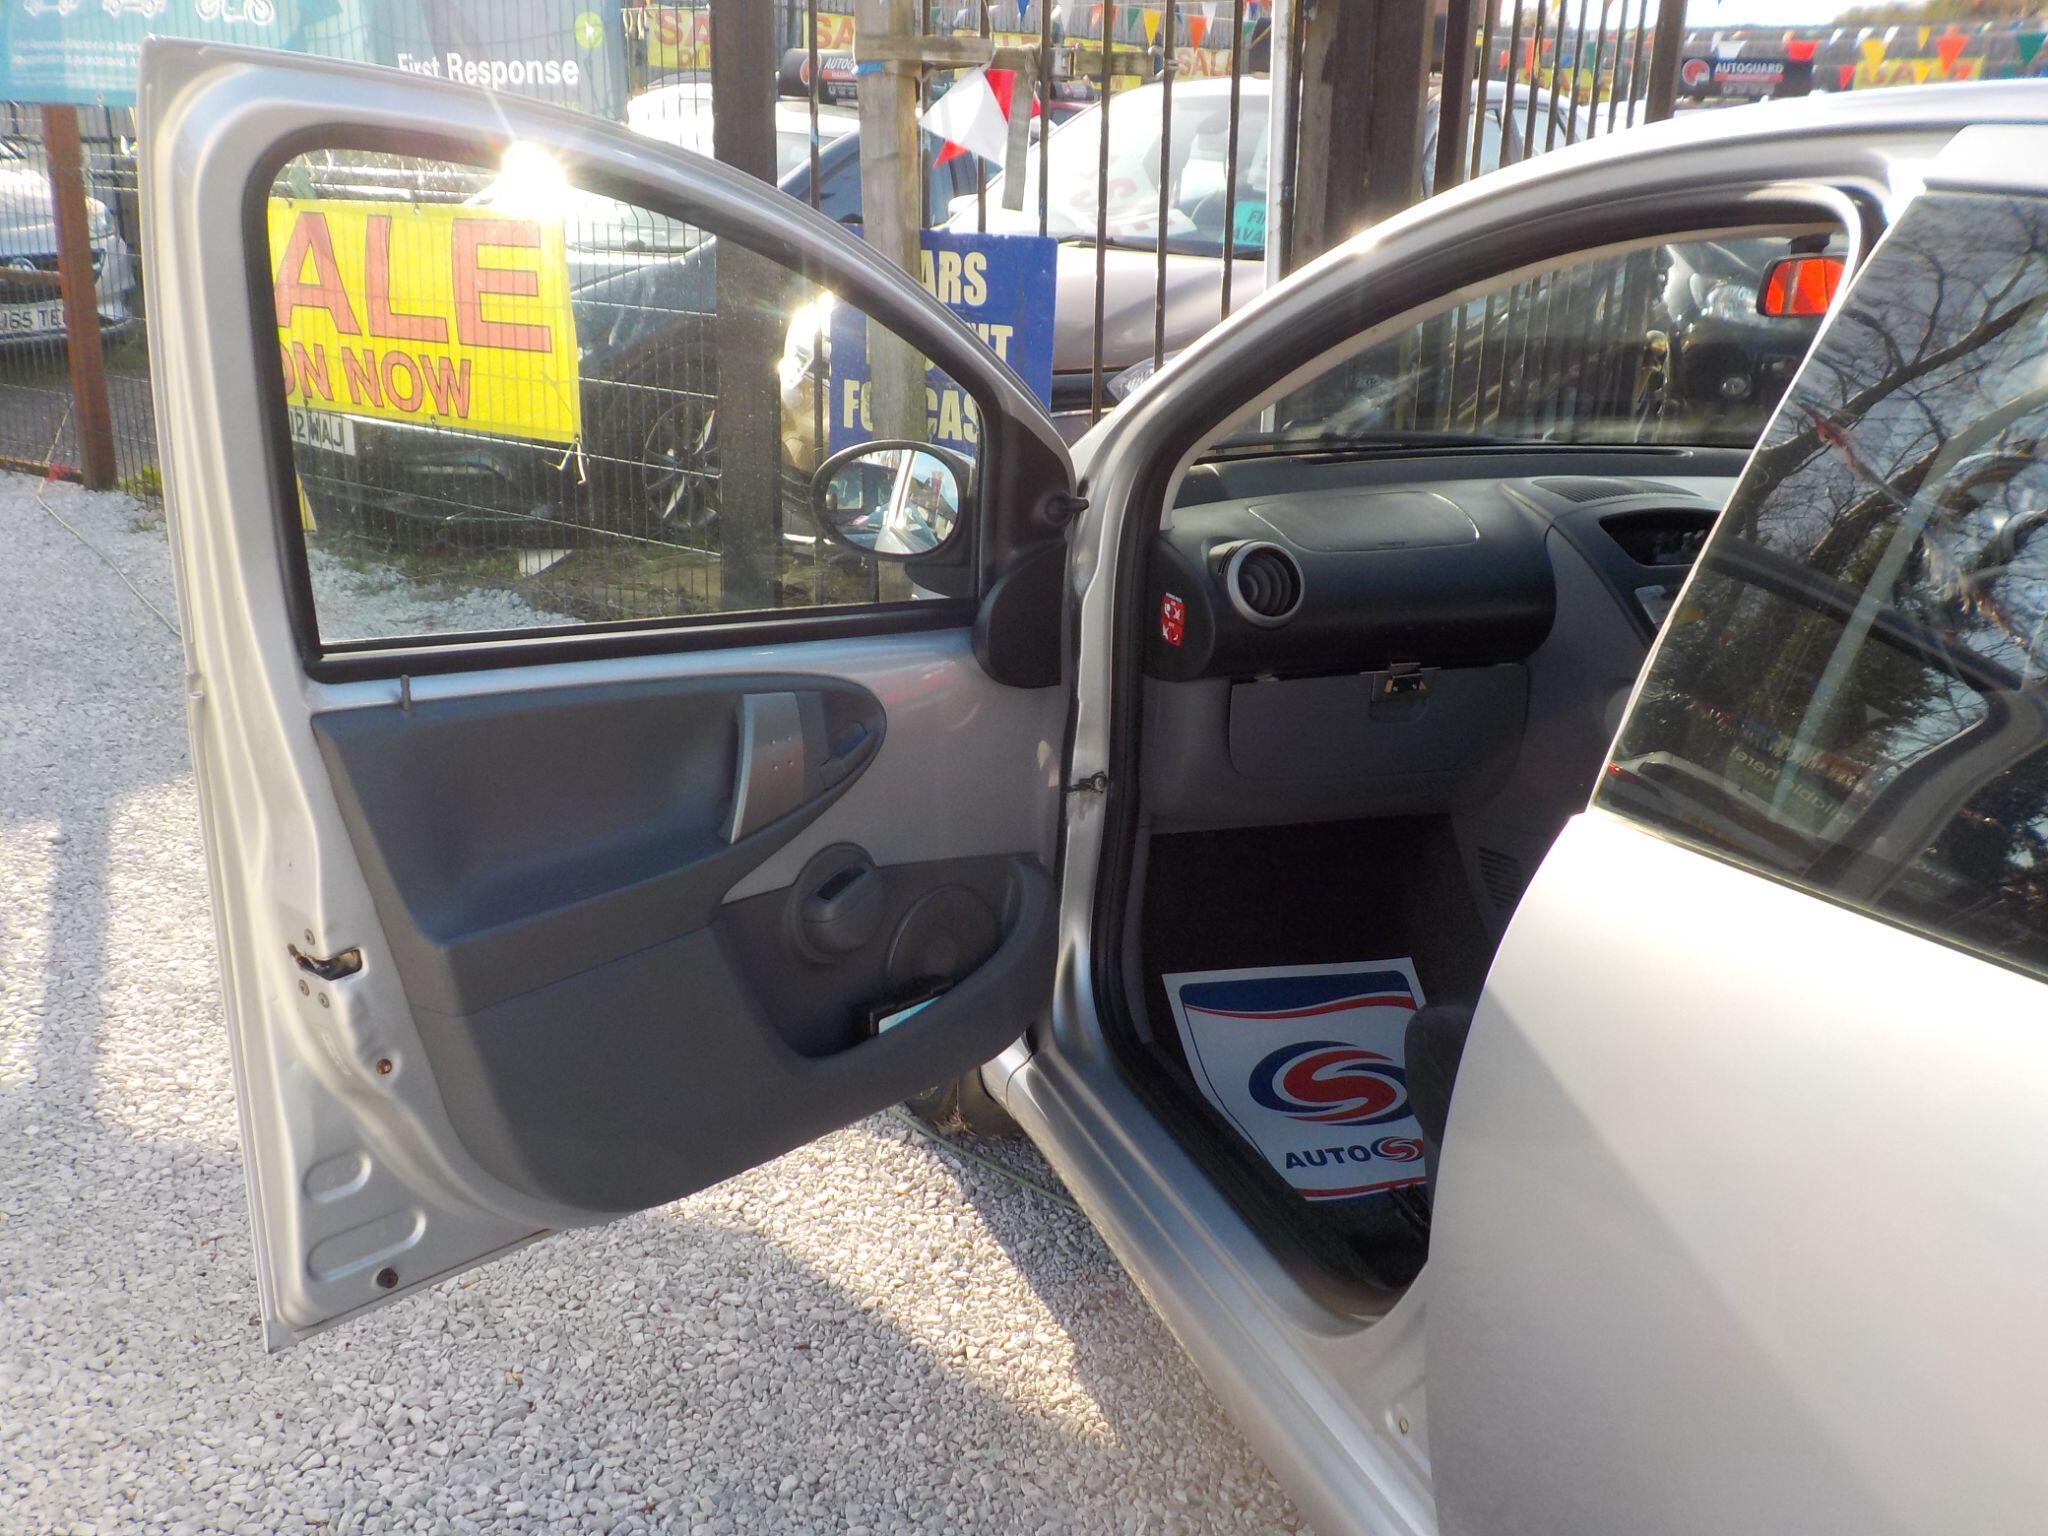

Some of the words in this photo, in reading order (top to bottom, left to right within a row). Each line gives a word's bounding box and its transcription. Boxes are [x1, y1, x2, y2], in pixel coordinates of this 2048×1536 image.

[398, 53, 439, 77] First
[447, 52, 579, 91] Response
[1715, 62, 1784, 74] AUTOGUARD
[341, 347, 471, 419] NOW
